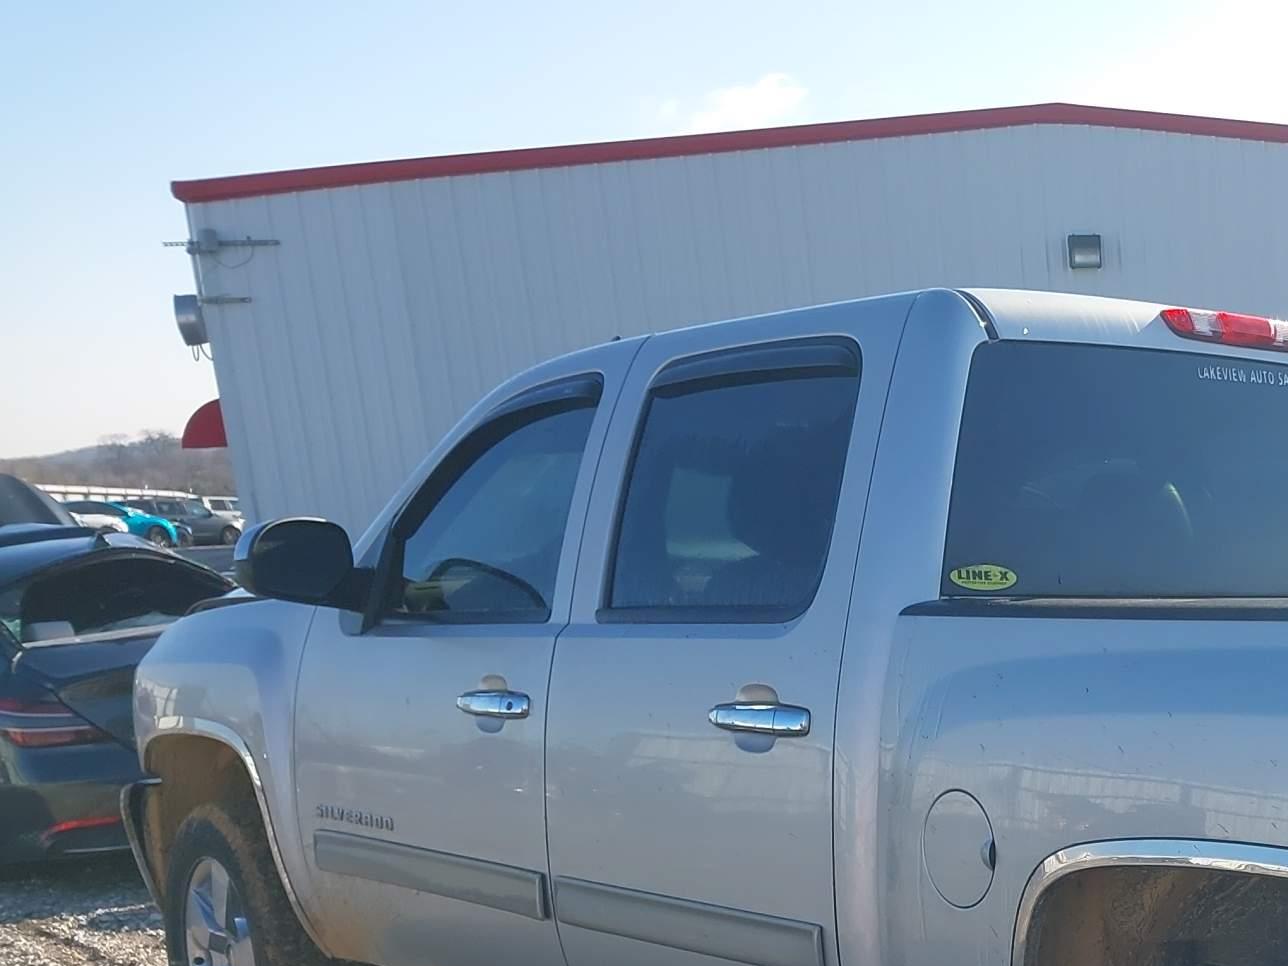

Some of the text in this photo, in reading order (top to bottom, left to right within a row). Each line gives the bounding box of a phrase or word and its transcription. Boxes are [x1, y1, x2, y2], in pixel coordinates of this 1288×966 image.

[1197, 365, 1246, 383] LAKEVIEW
[1250, 371, 1275, 385] AUTO
[957, 569, 1009, 581] LINE-X
[315, 804, 394, 831] SILVERADO
